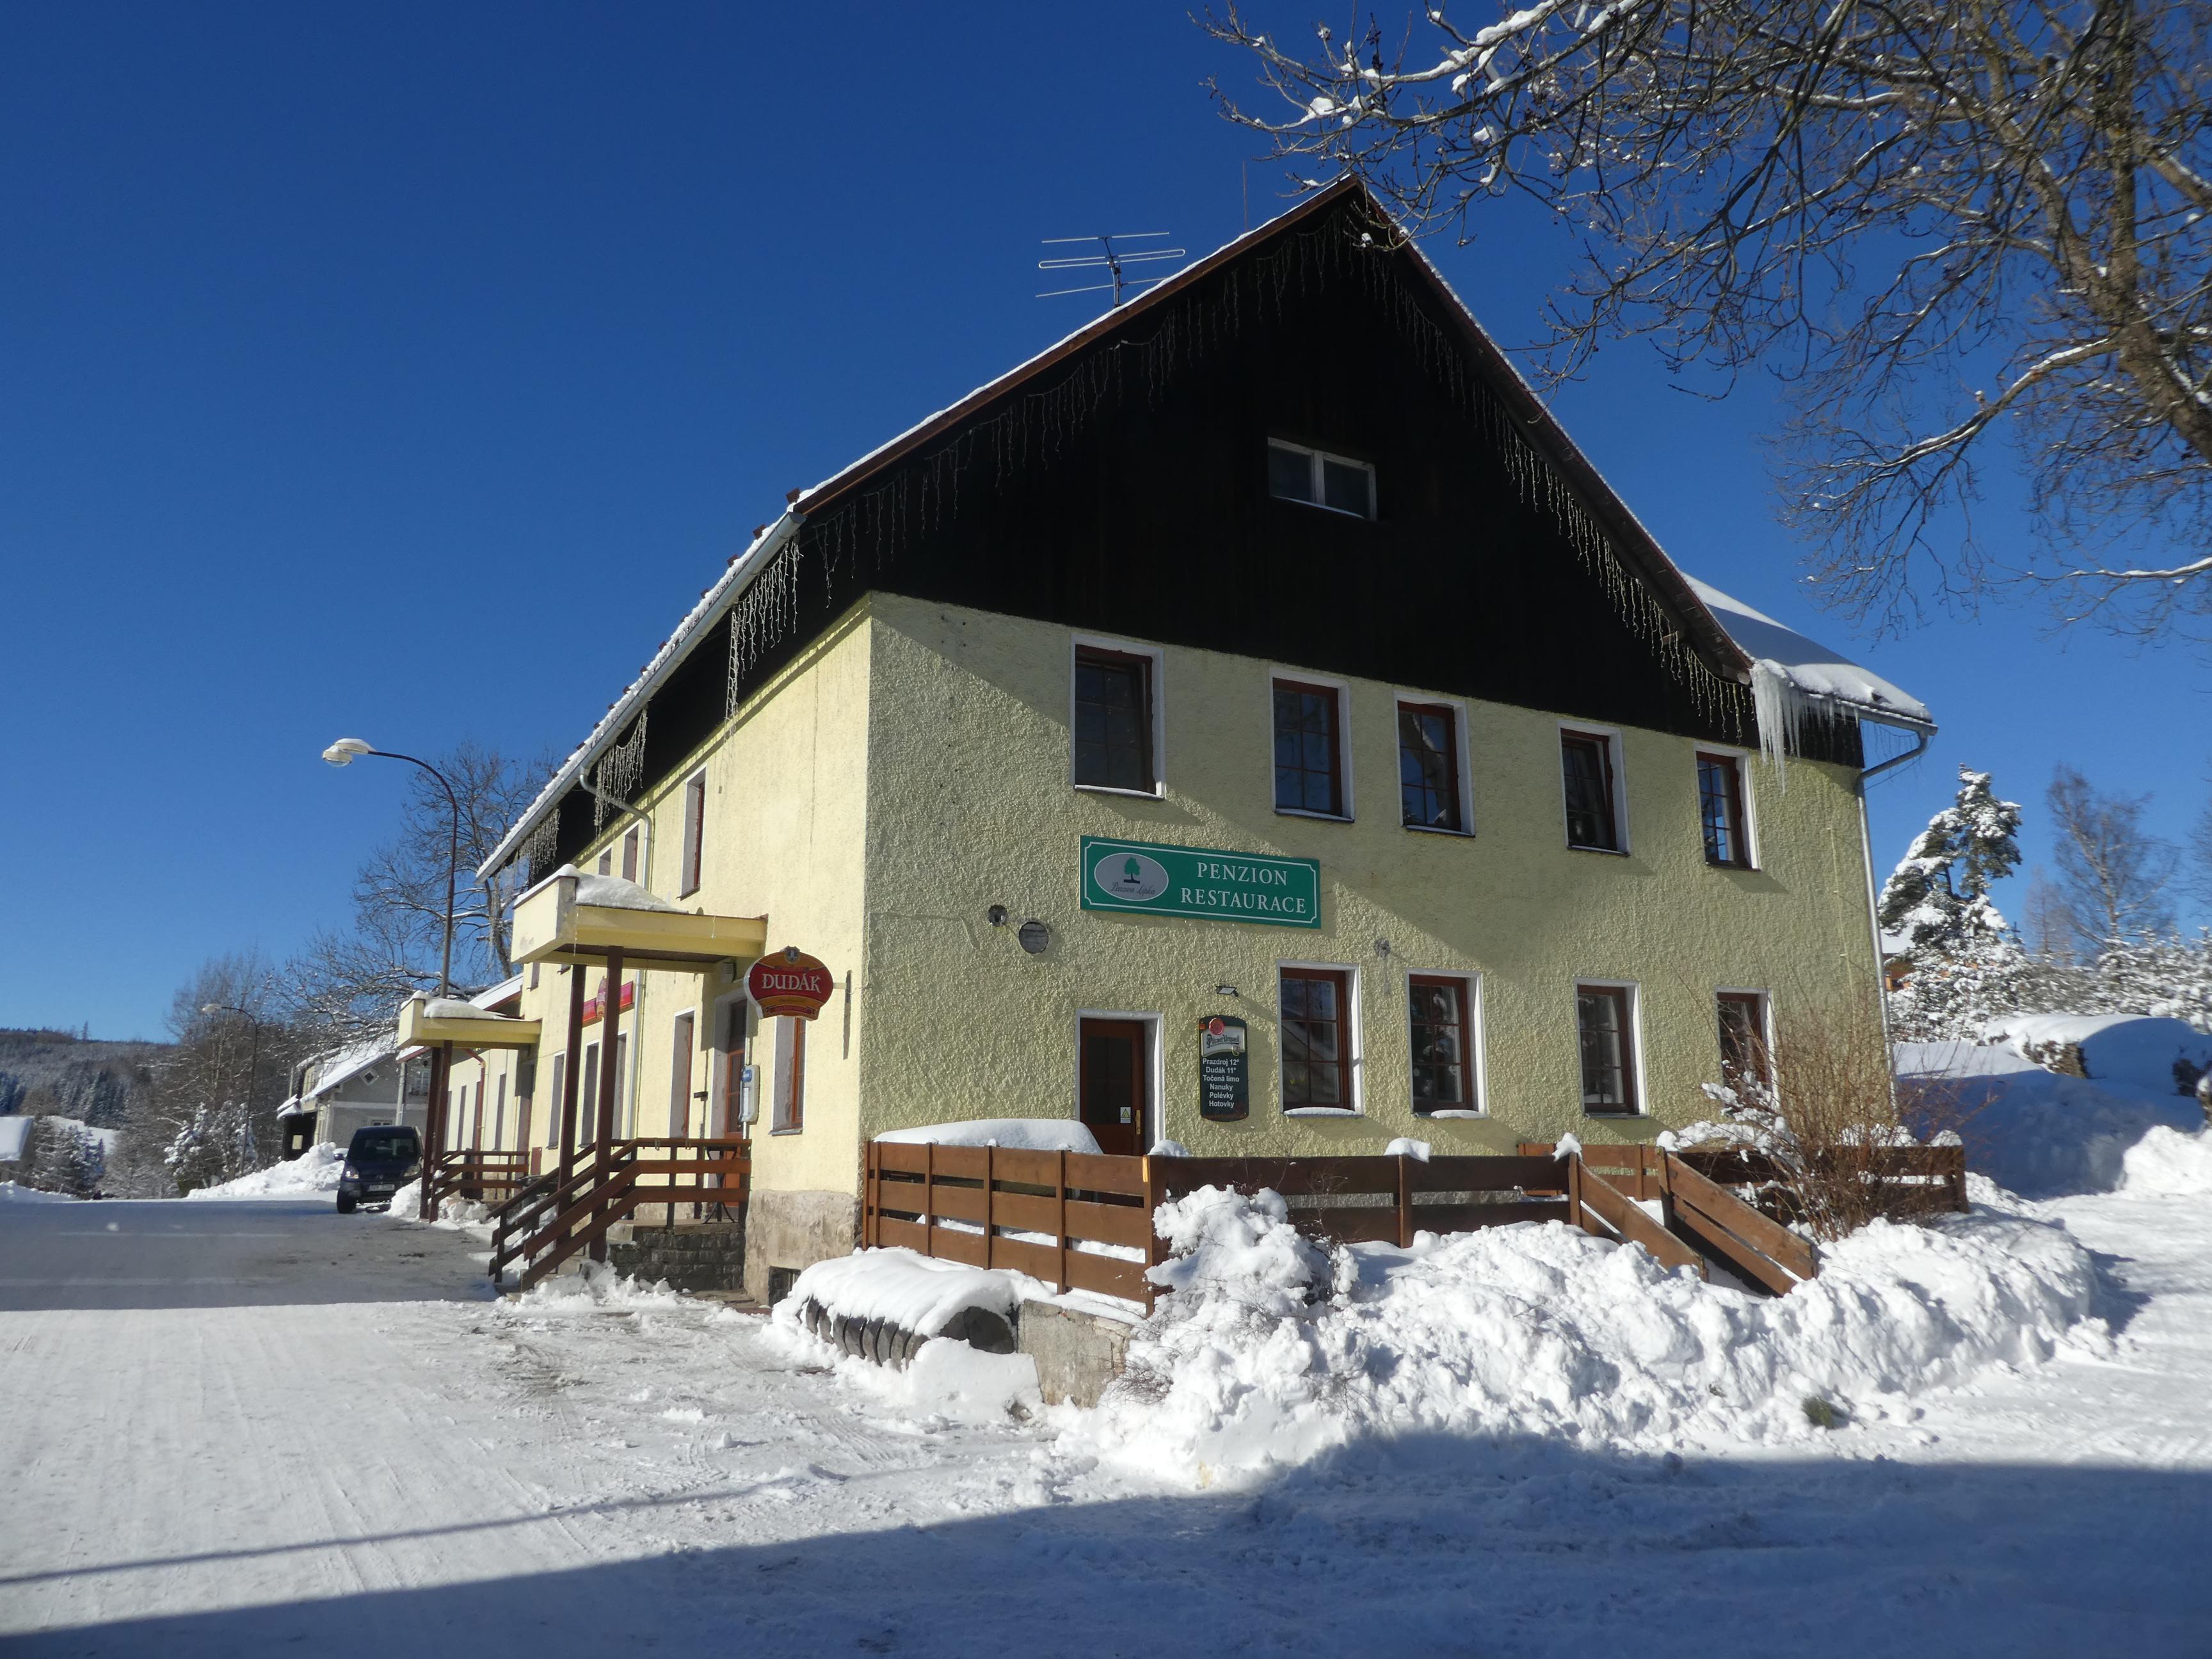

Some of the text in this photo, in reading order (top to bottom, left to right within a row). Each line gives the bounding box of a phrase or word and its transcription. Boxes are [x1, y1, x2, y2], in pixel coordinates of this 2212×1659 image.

[1196, 862, 1287, 886] PENZION
[1181, 887, 1306, 914] RESTAURACE
[762, 973, 822, 993] DUDÁK
[1203, 1058, 1228, 1066] Prazdroj
[1210, 1083, 1233, 1092] Nanuky
[1209, 1091, 1234, 1100] Polévky
[1208, 1100, 1235, 1109] Hotovky
